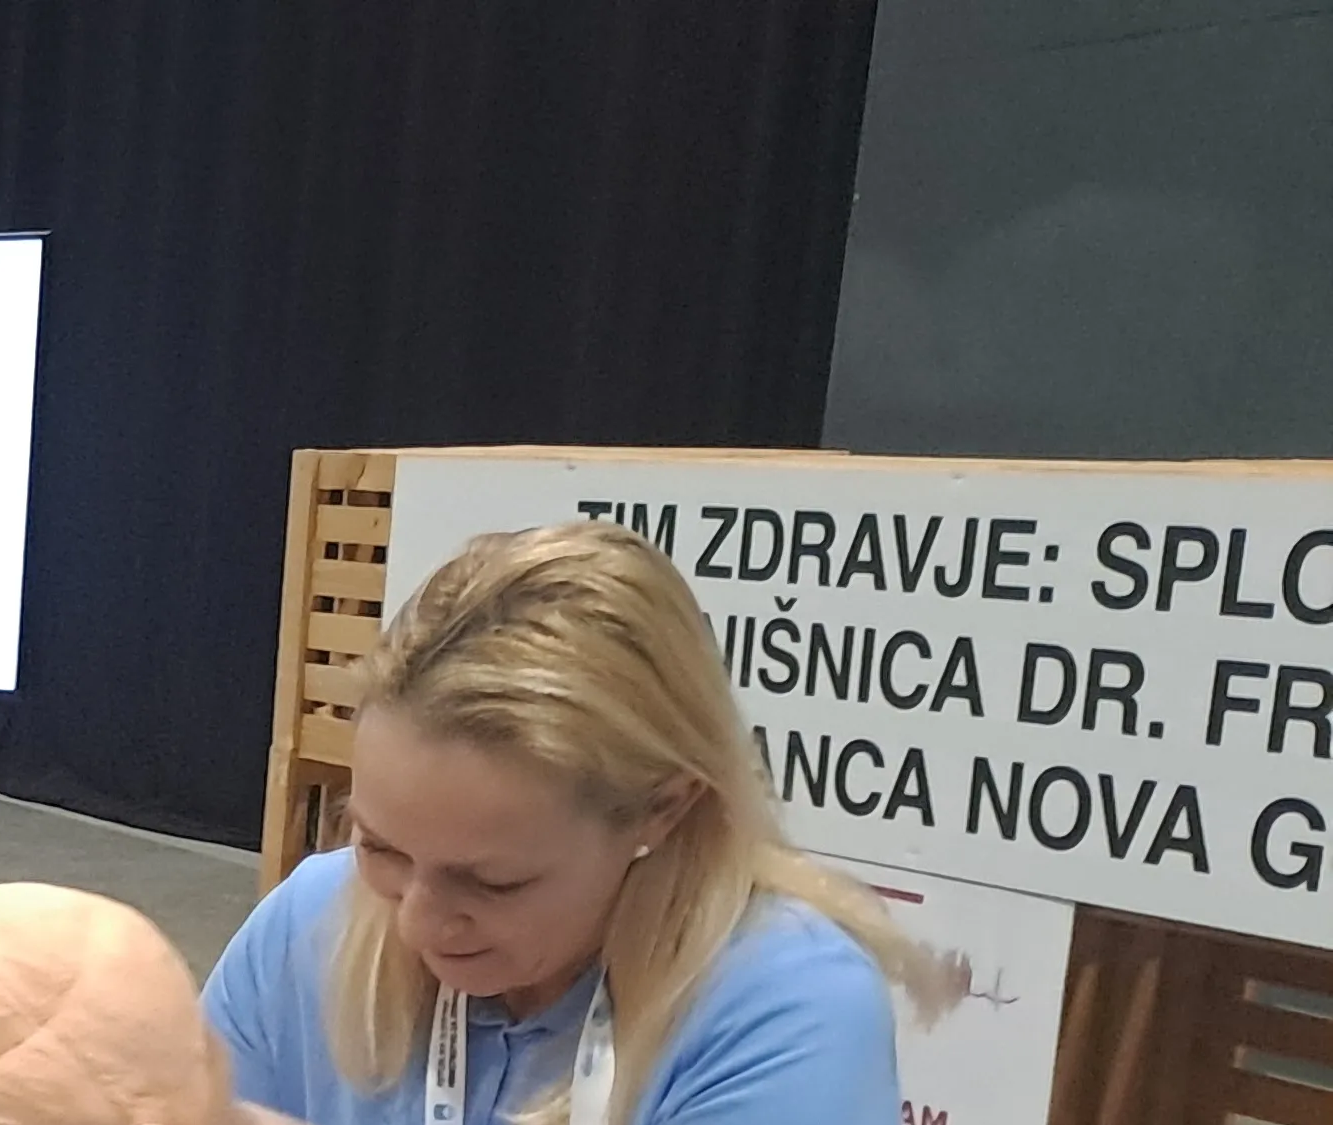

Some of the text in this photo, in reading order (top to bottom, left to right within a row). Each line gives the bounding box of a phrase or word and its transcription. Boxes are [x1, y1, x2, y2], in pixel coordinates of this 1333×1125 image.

[694, 505, 1060, 603] ZDRAVJE:
[1017, 641, 1164, 739] DR.
[1205, 658, 1333, 759] FR
[965, 756, 1211, 874] NOVA
